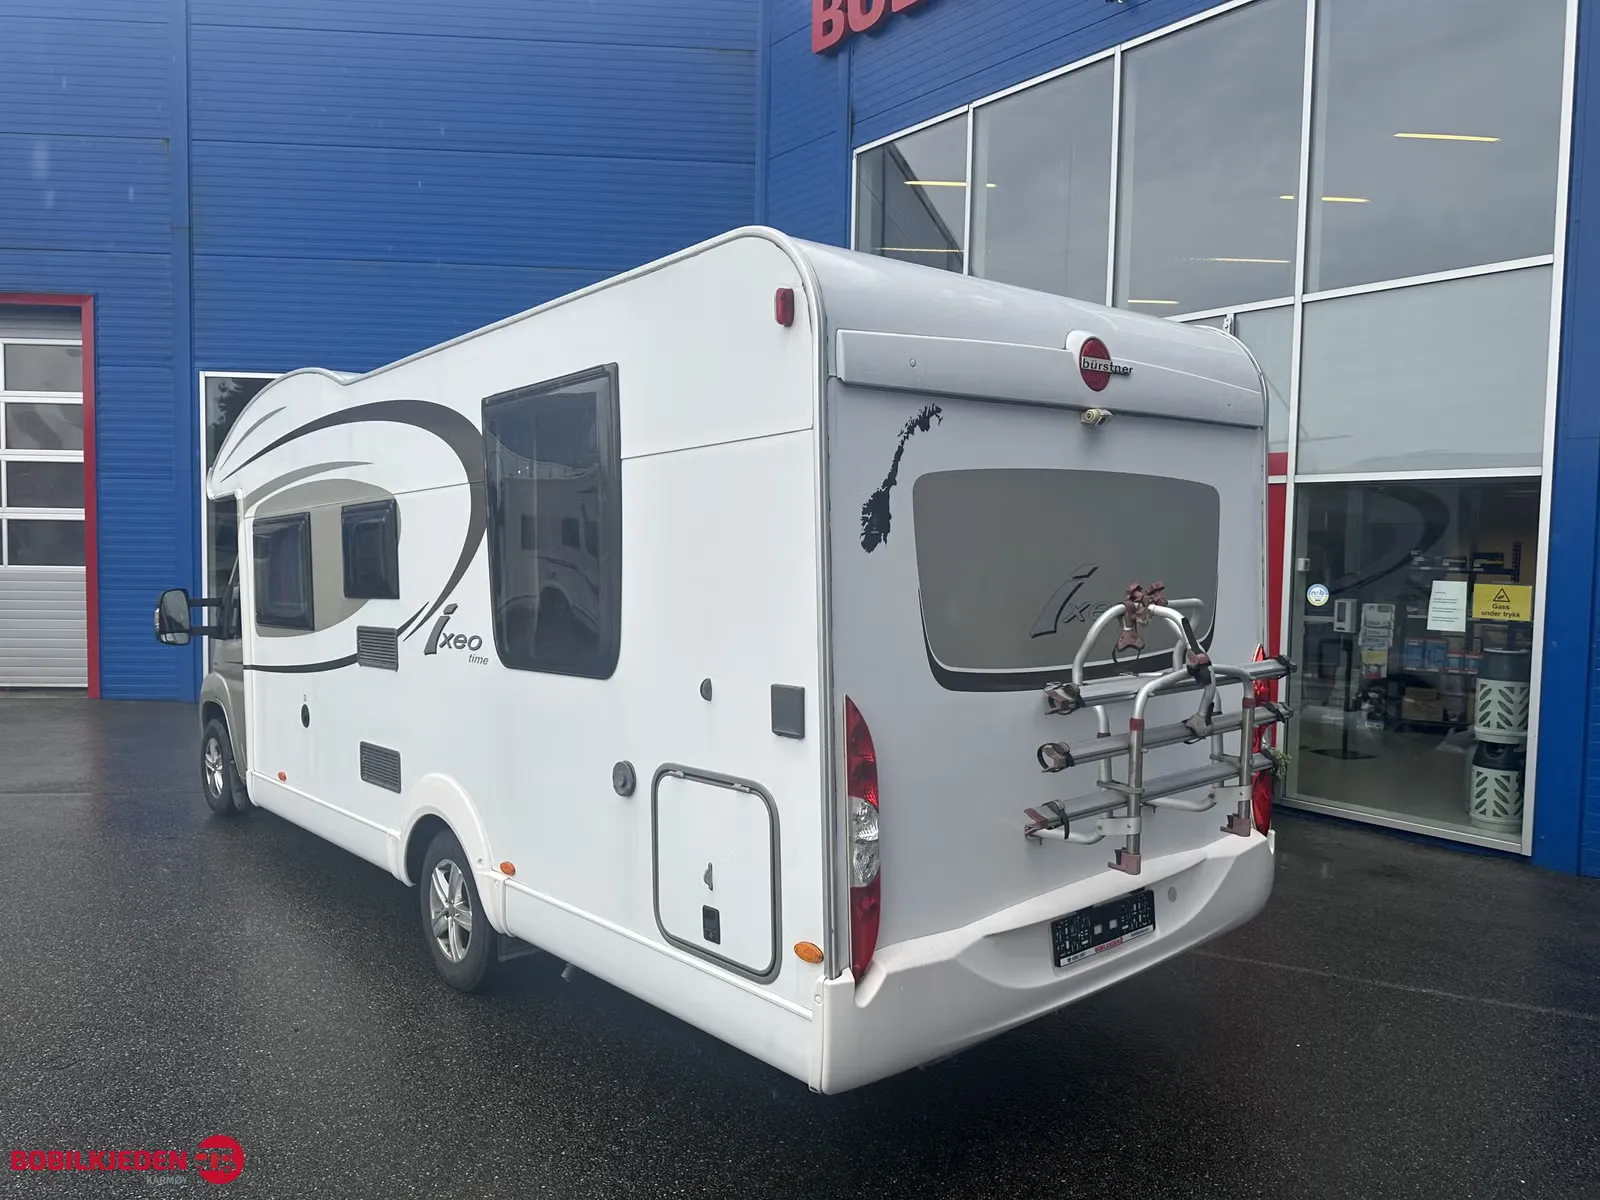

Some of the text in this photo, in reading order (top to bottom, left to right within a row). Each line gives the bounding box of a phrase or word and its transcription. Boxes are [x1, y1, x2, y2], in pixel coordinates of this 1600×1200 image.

[811, 0, 918, 54] BO
[1081, 358, 1133, 375] bürstner
[424, 603, 483, 655] ixeo
[468, 654, 489, 665] time
